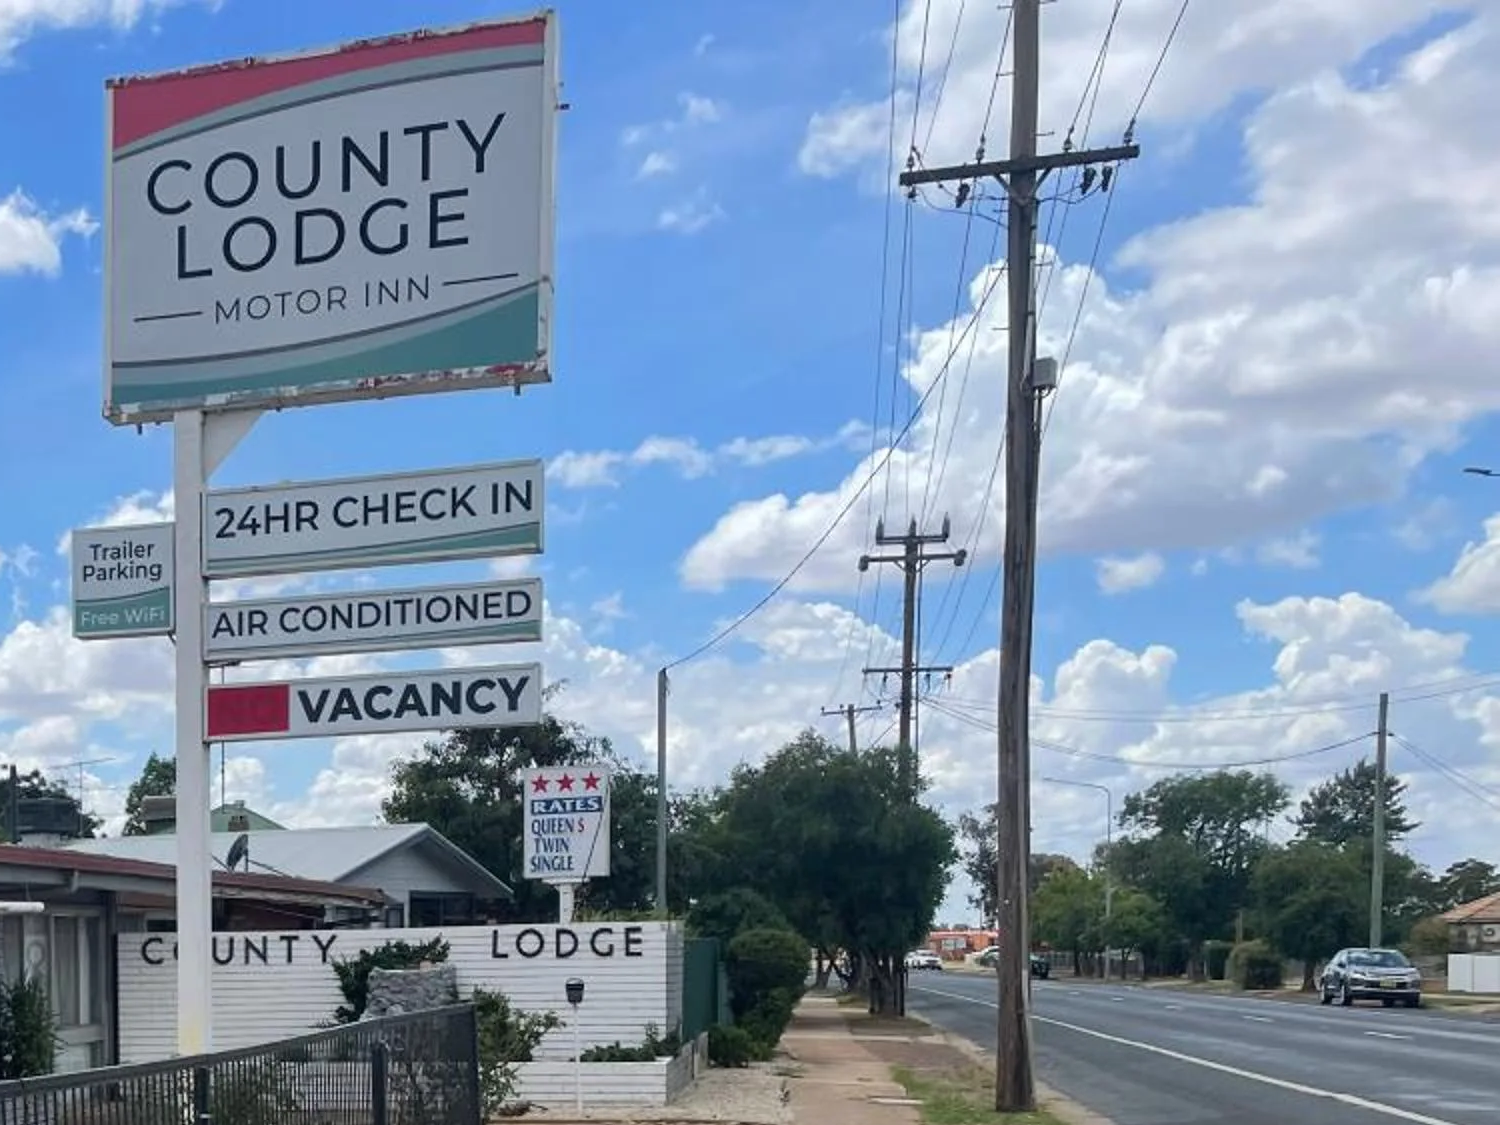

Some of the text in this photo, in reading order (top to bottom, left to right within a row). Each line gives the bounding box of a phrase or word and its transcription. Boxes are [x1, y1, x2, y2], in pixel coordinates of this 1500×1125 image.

[146, 112, 507, 216] COUNTY
[177, 187, 470, 280] LODGE
[214, 274, 431, 324] MOTOR INN
[214, 479, 534, 540] 24HR CHECK IN
[88, 540, 155, 561] Trailer
[82, 561, 163, 583] Parking
[81, 605, 165, 627] Free WiFi
[211, 589, 532, 640] AIR CONDITIONED
[297, 675, 530, 724] VACANCY
[532, 799, 600, 813] RATES
[530, 855, 574, 873] SINGLE
[534, 837, 570, 854] TWIN
[141, 926, 643, 966] CUNTY LODGE
